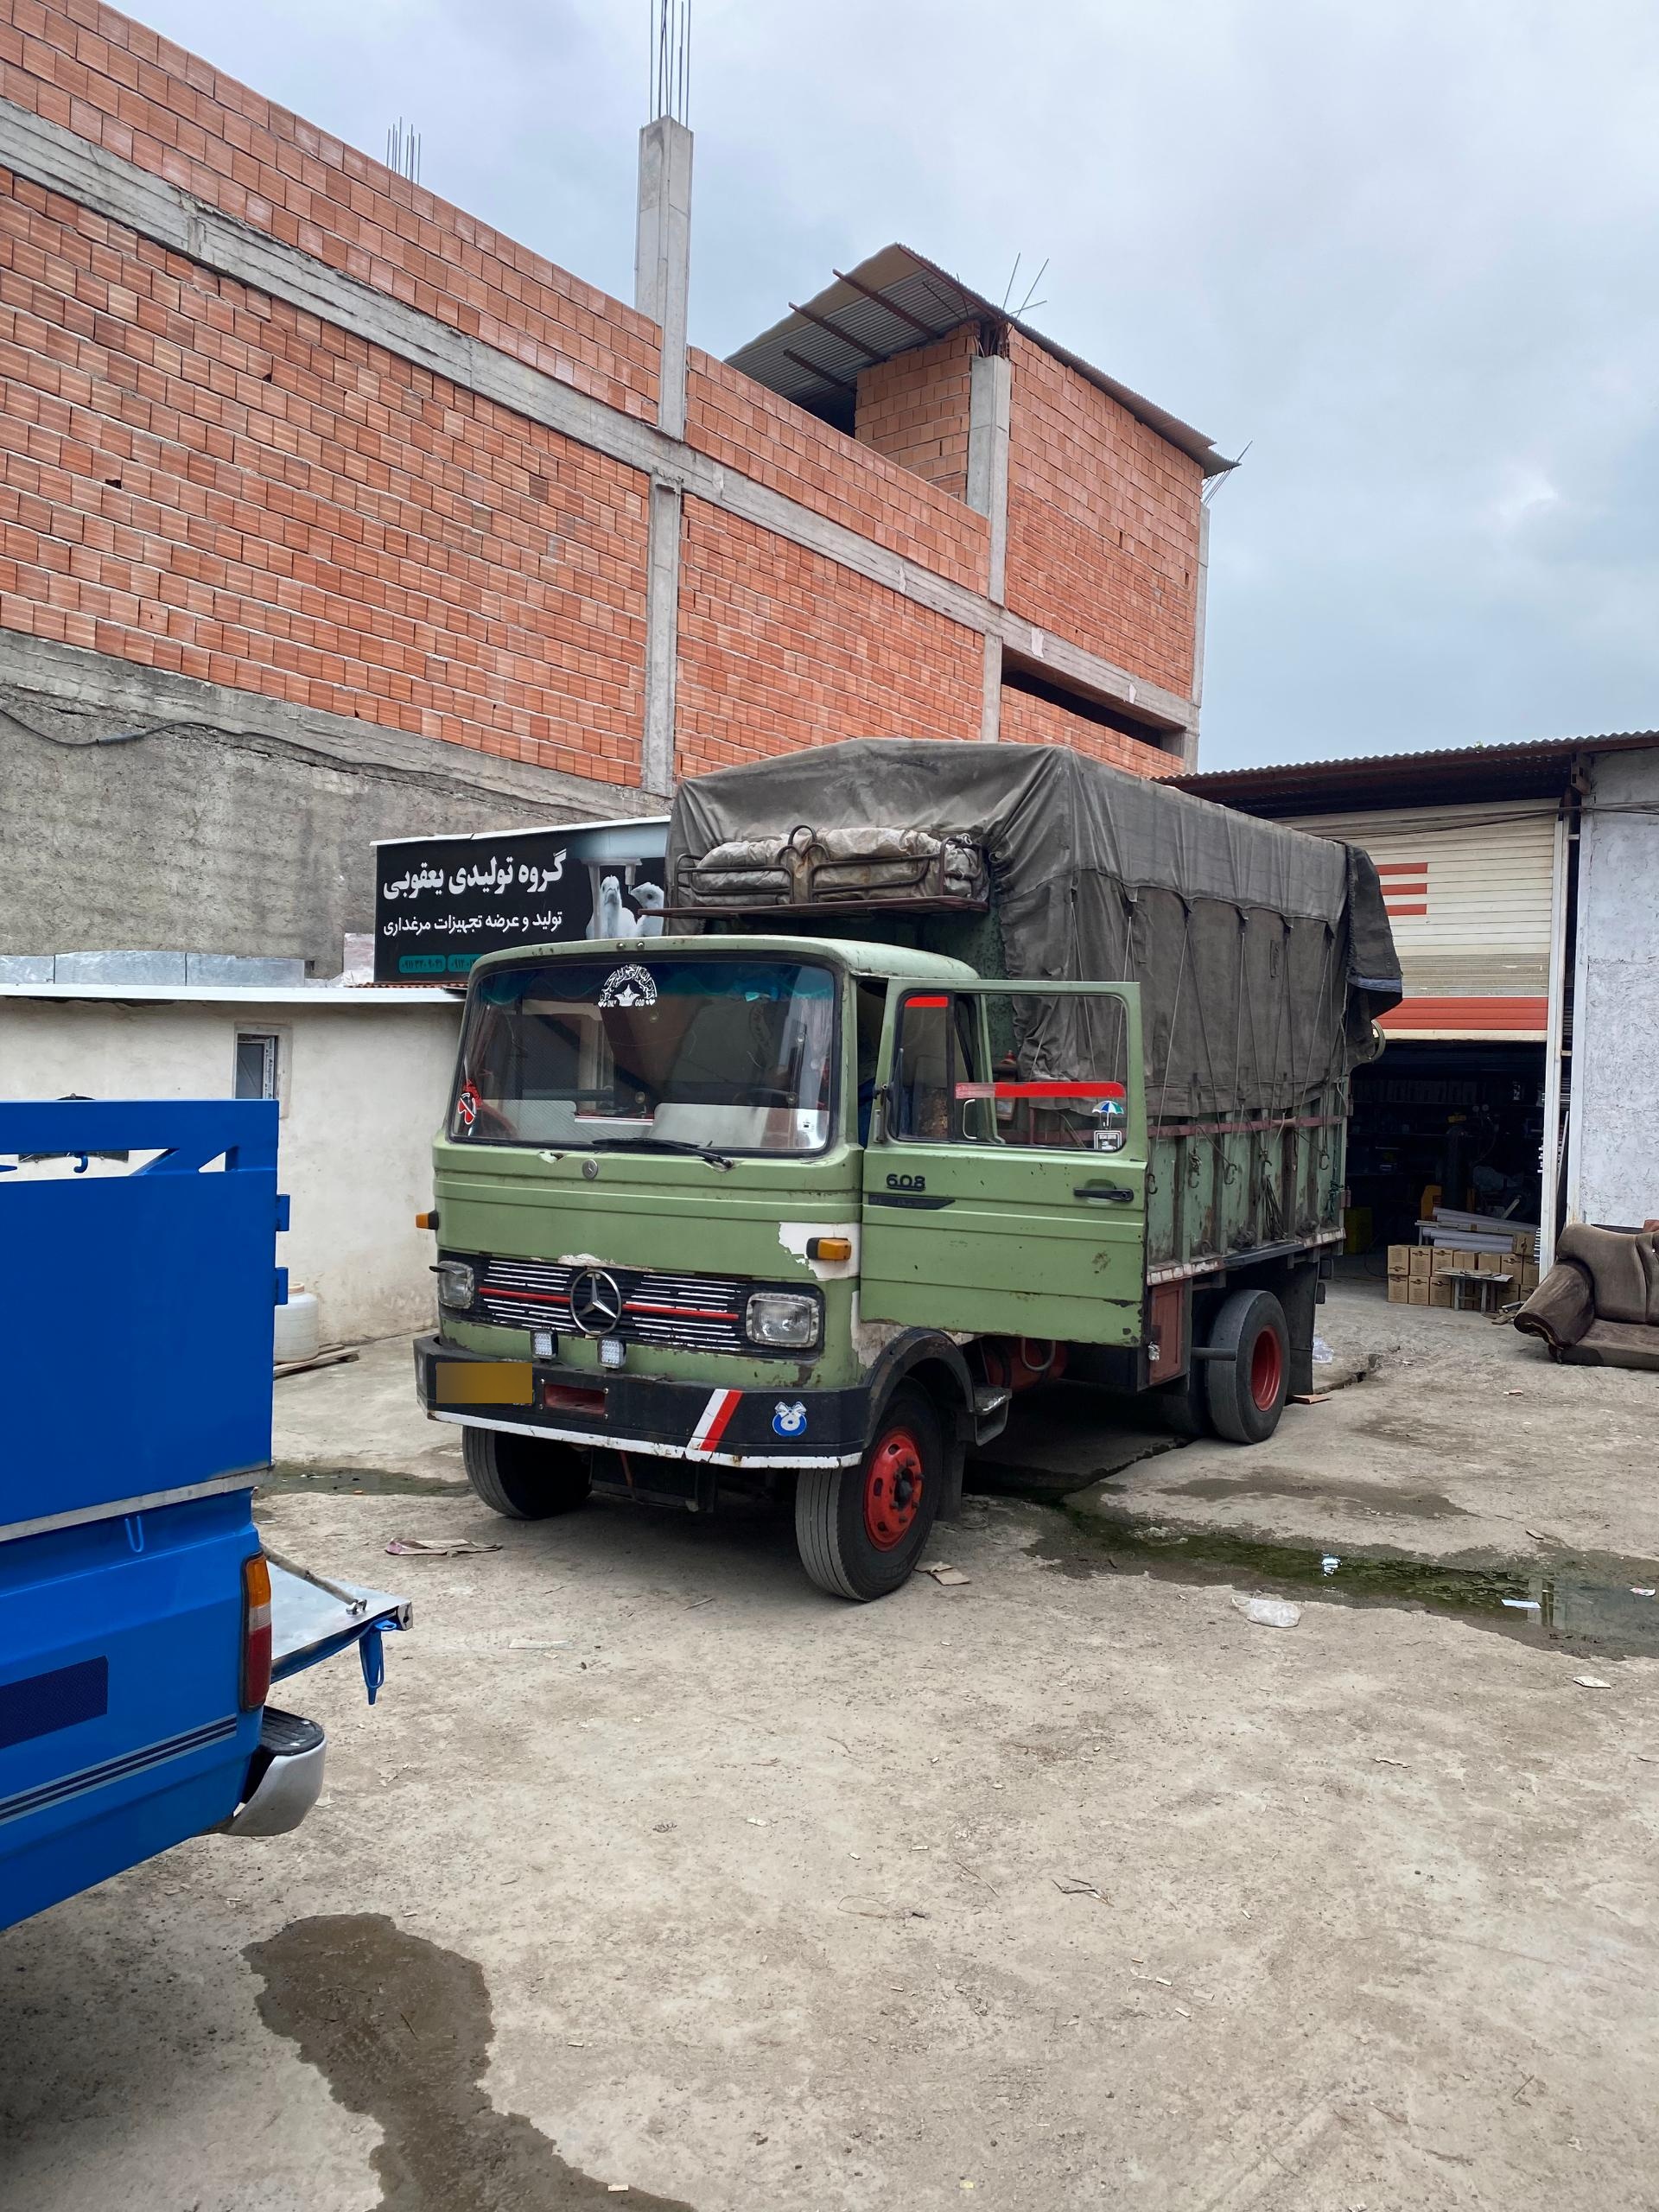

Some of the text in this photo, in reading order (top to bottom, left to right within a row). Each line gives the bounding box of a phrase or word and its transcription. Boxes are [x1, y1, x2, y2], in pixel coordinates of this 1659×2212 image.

[383, 849, 567, 899] گروه تولیدی یعقوبی
[383, 911, 563, 937] تولید و عرضه تجهیزات مرغداری
[886, 1173, 925, 1191] 608
